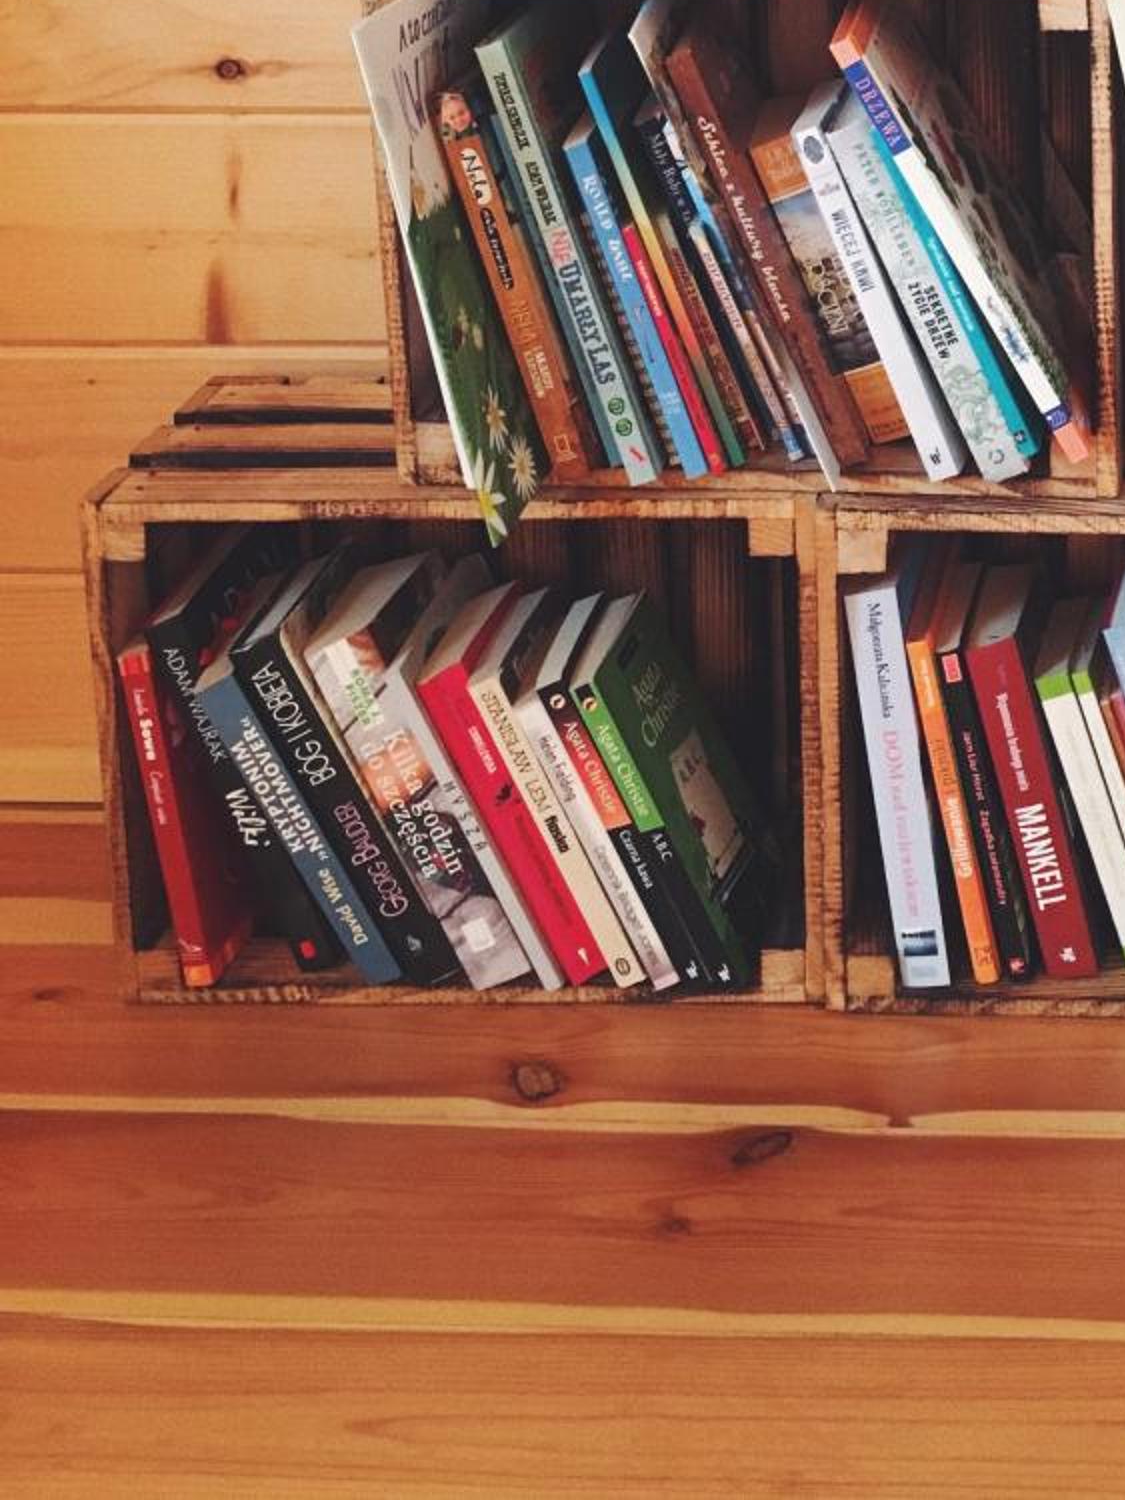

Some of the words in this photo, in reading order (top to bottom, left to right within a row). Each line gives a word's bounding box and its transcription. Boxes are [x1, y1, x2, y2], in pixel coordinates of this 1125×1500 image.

[853, 75, 904, 147] DRZEWA
[460, 147, 491, 203] Nela
[524, 159, 544, 186] ADAM
[532, 183, 559, 225] WAJRAK
[580, 172, 615, 232] ROALD
[731, 194, 765, 261] kultury
[831, 210, 861, 258] WIĘCEJ
[849, 257, 875, 293] KRWI
[906, 280, 933, 317] ŻYCIE
[923, 316, 951, 360] DRZEW
[922, 283, 959, 347] SEKRETNE
[588, 345, 616, 385] LAS
[164, 648, 196, 697] ADAM
[188, 701, 229, 764] WAJRAK
[251, 661, 308, 733] KOBIETA
[137, 717, 161, 761] Sowa
[296, 739, 337, 786] BÓG
[564, 720, 589, 761] Agata
[584, 759, 616, 811] Christie
[597, 724, 623, 763] Agata
[617, 761, 650, 817] Christie
[225, 788, 271, 846] Wilki
[230, 741, 304, 854] KRYPTONIM
[361, 743, 385, 772] do
[373, 776, 441, 878] szczęścia
[386, 729, 424, 795] Kilka
[412, 799, 462, 875] godzin
[523, 777, 551, 813] LEM
[317, 868, 343, 905] Wise
[617, 828, 643, 863] Czarna
[635, 862, 656, 889] kawa
[1015, 803, 1067, 910] MANKELL
[335, 903, 369, 946] David
